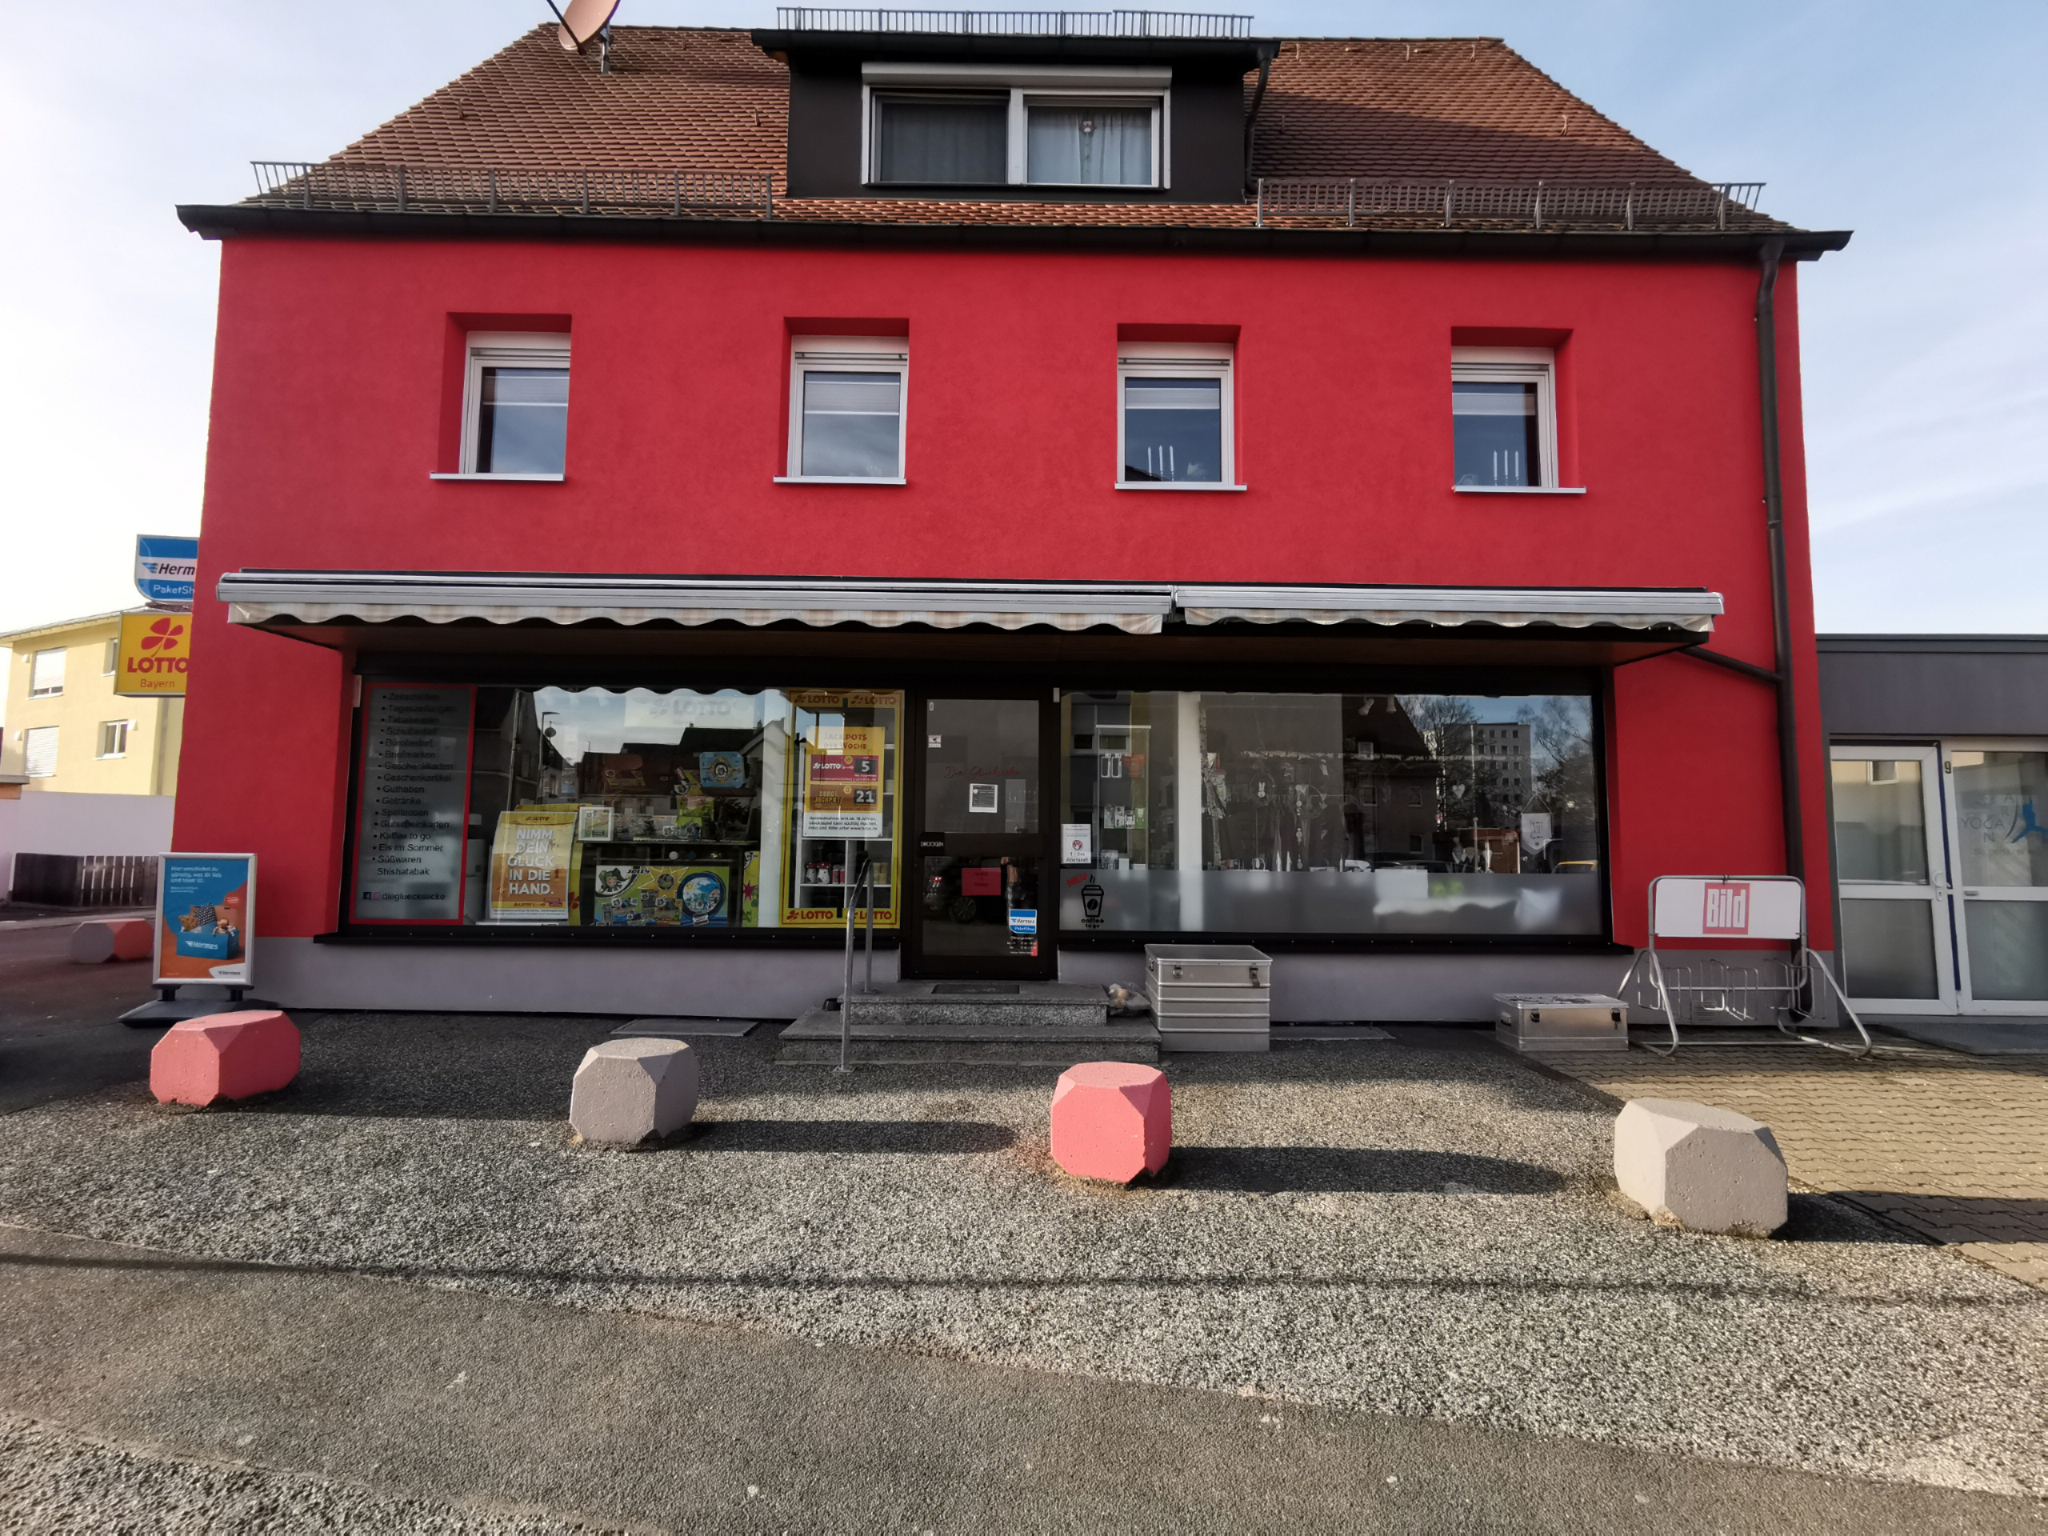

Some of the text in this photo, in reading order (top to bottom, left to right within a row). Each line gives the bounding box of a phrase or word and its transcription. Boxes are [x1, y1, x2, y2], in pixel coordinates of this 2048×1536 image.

[127, 656, 190, 674] LOTTO
[140, 678, 175, 690] Bayern
[808, 694, 840, 704] LOTTO
[865, 696, 897, 706] LOTTO
[673, 699, 731, 716] LOTTO
[386, 727, 438, 735] Schulbedarf
[385, 750, 436, 759] Briefmarken
[861, 760, 870, 773] 5
[1944, 761, 1952, 775] 9
[944, 766, 964, 779] Die
[382, 785, 425, 793] Guthaben
[382, 797, 422, 805] Getränke
[856, 790, 875, 803] 21
[1960, 817, 2005, 830] YOGA
[379, 832, 431, 842] Kaffee to go
[516, 829, 553, 840] NIMM
[378, 843, 444, 852] Eis im Sommer
[515, 842, 550, 854] DEIN
[377, 855, 422, 864] Süßwaren
[377, 867, 430, 876] Shishatabak
[509, 870, 551, 881] IN DIE
[1067, 872, 1088, 888] NEU
[508, 883, 554, 895] HAND.
[1706, 888, 1747, 928] Bild
[800, 910, 834, 920] LOTTO
[859, 910, 893, 920] LTTO
[193, 941, 219, 950] Hermes
